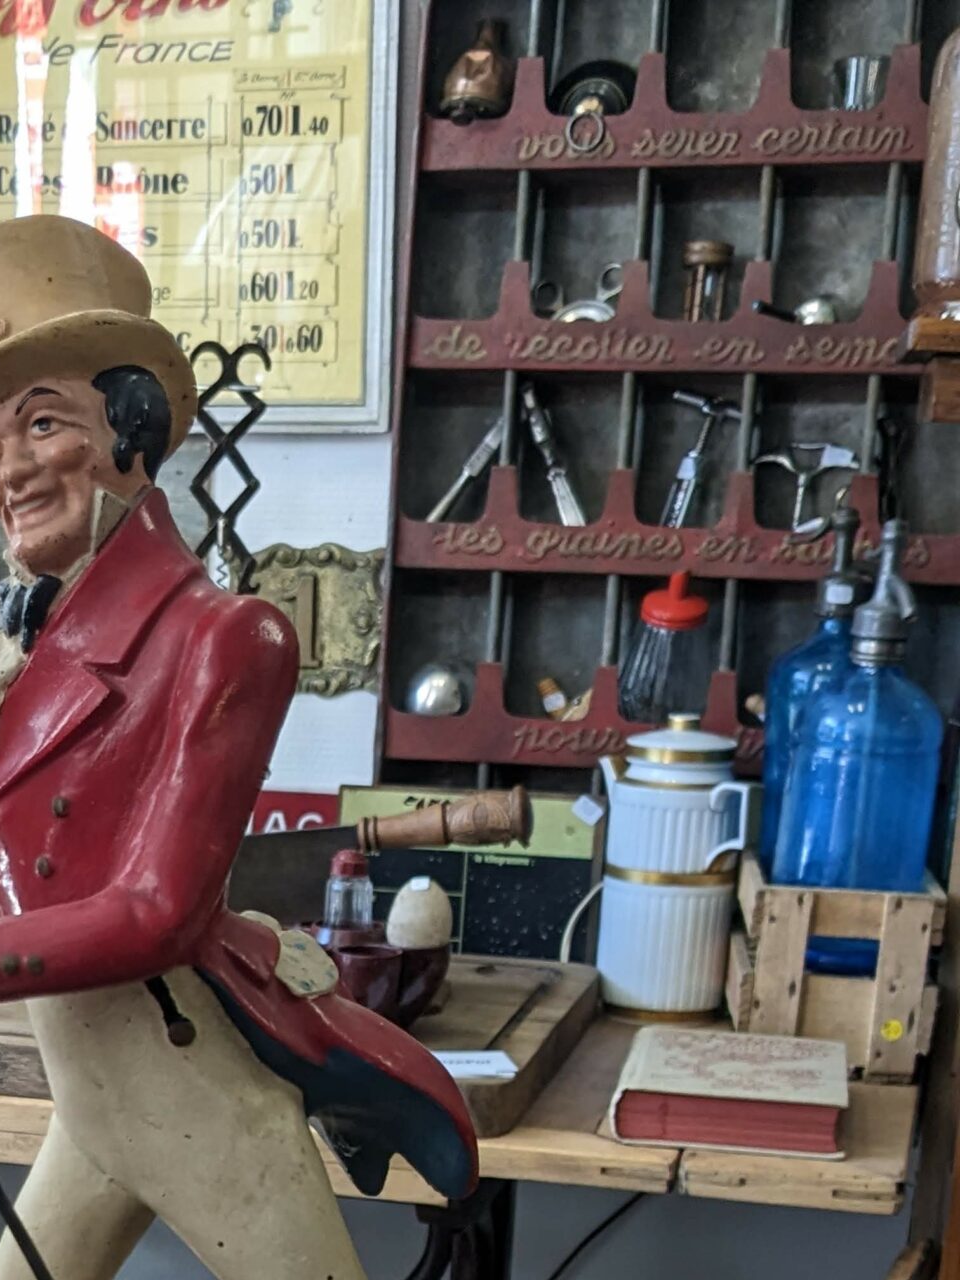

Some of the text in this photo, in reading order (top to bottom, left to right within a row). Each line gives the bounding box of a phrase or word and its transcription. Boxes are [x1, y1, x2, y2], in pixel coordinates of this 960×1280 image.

[89, 34, 235, 66] France
[96, 111, 206, 143] Sancerre
[751, 112, 913, 157] certain
[693, 335, 767, 365] en
[694, 534, 758, 563] en
